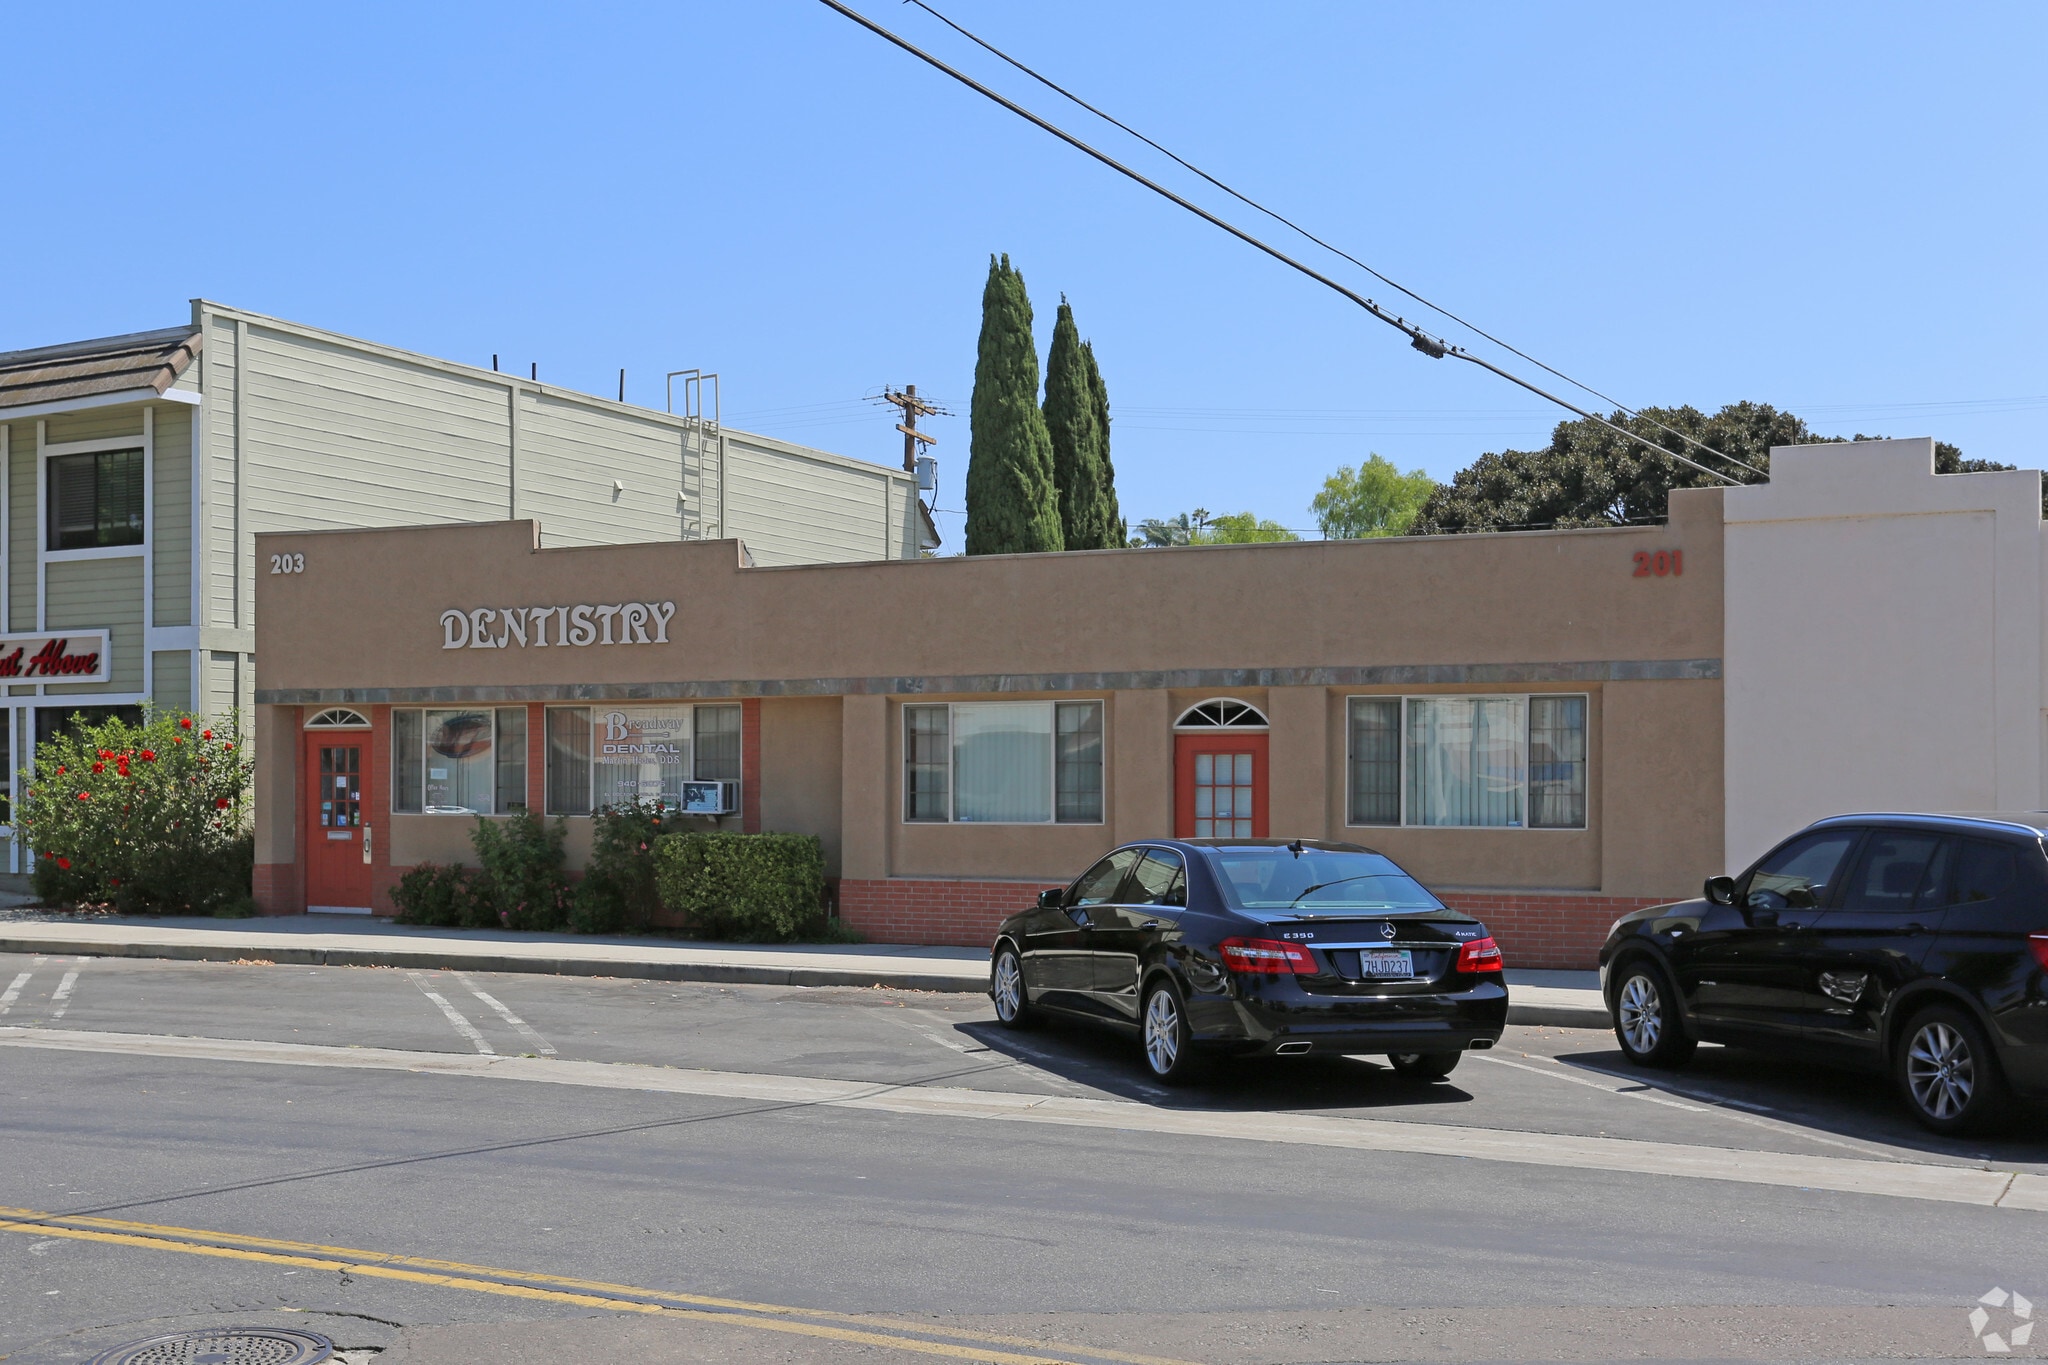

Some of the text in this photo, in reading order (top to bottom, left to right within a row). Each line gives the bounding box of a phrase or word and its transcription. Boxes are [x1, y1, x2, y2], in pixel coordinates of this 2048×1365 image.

[270, 553, 305, 575] 203
[1632, 549, 1683, 577] 201
[439, 601, 676, 650] DENTISTRY
[0, 638, 99, 677] ut Above
[604, 711, 683, 740] Broadway
[603, 743, 680, 754] DENTAL
[1364, 960, 1408, 973] 7HJD237
